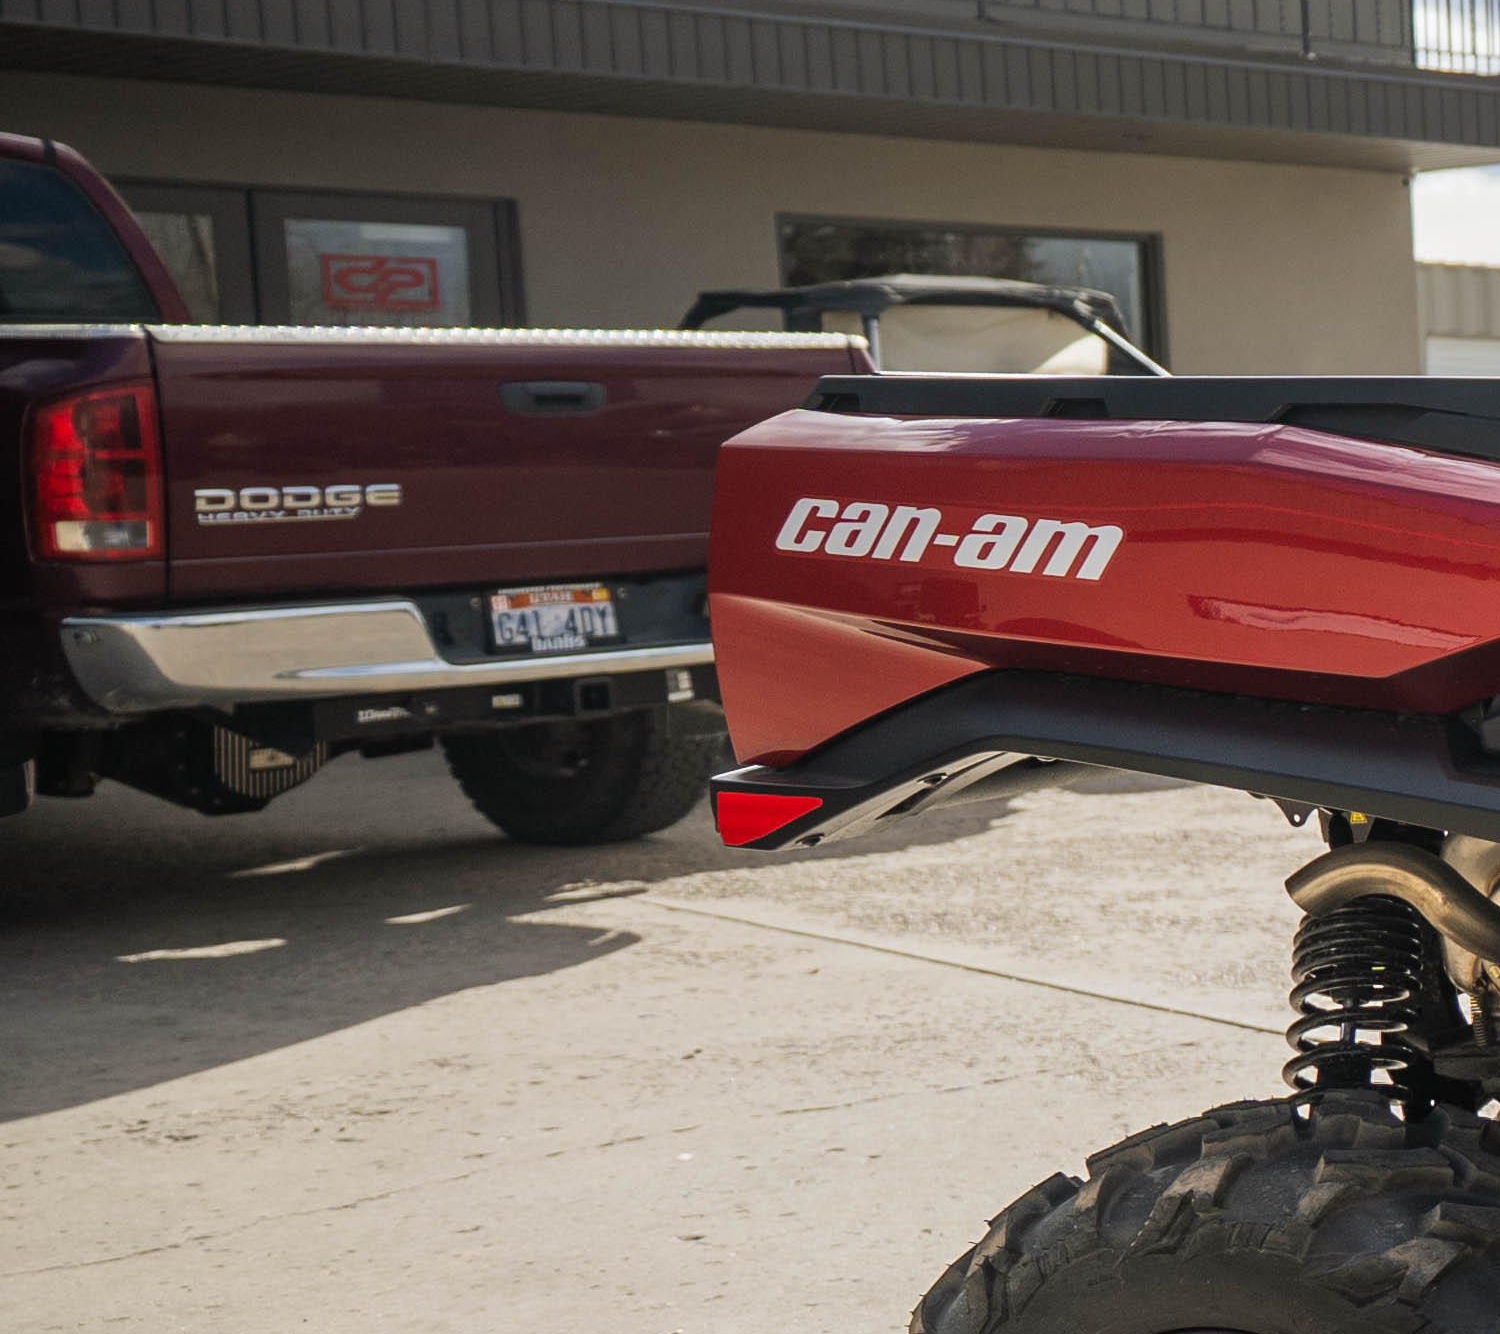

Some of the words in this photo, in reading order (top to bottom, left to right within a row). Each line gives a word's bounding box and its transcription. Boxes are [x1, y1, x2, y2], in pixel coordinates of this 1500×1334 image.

[194, 483, 402, 511] DODGE
[198, 511, 286, 522] HEAVY
[297, 507, 360, 518] DUTY
[775, 498, 1124, 581] can-am
[529, 590, 573, 604] UTAH
